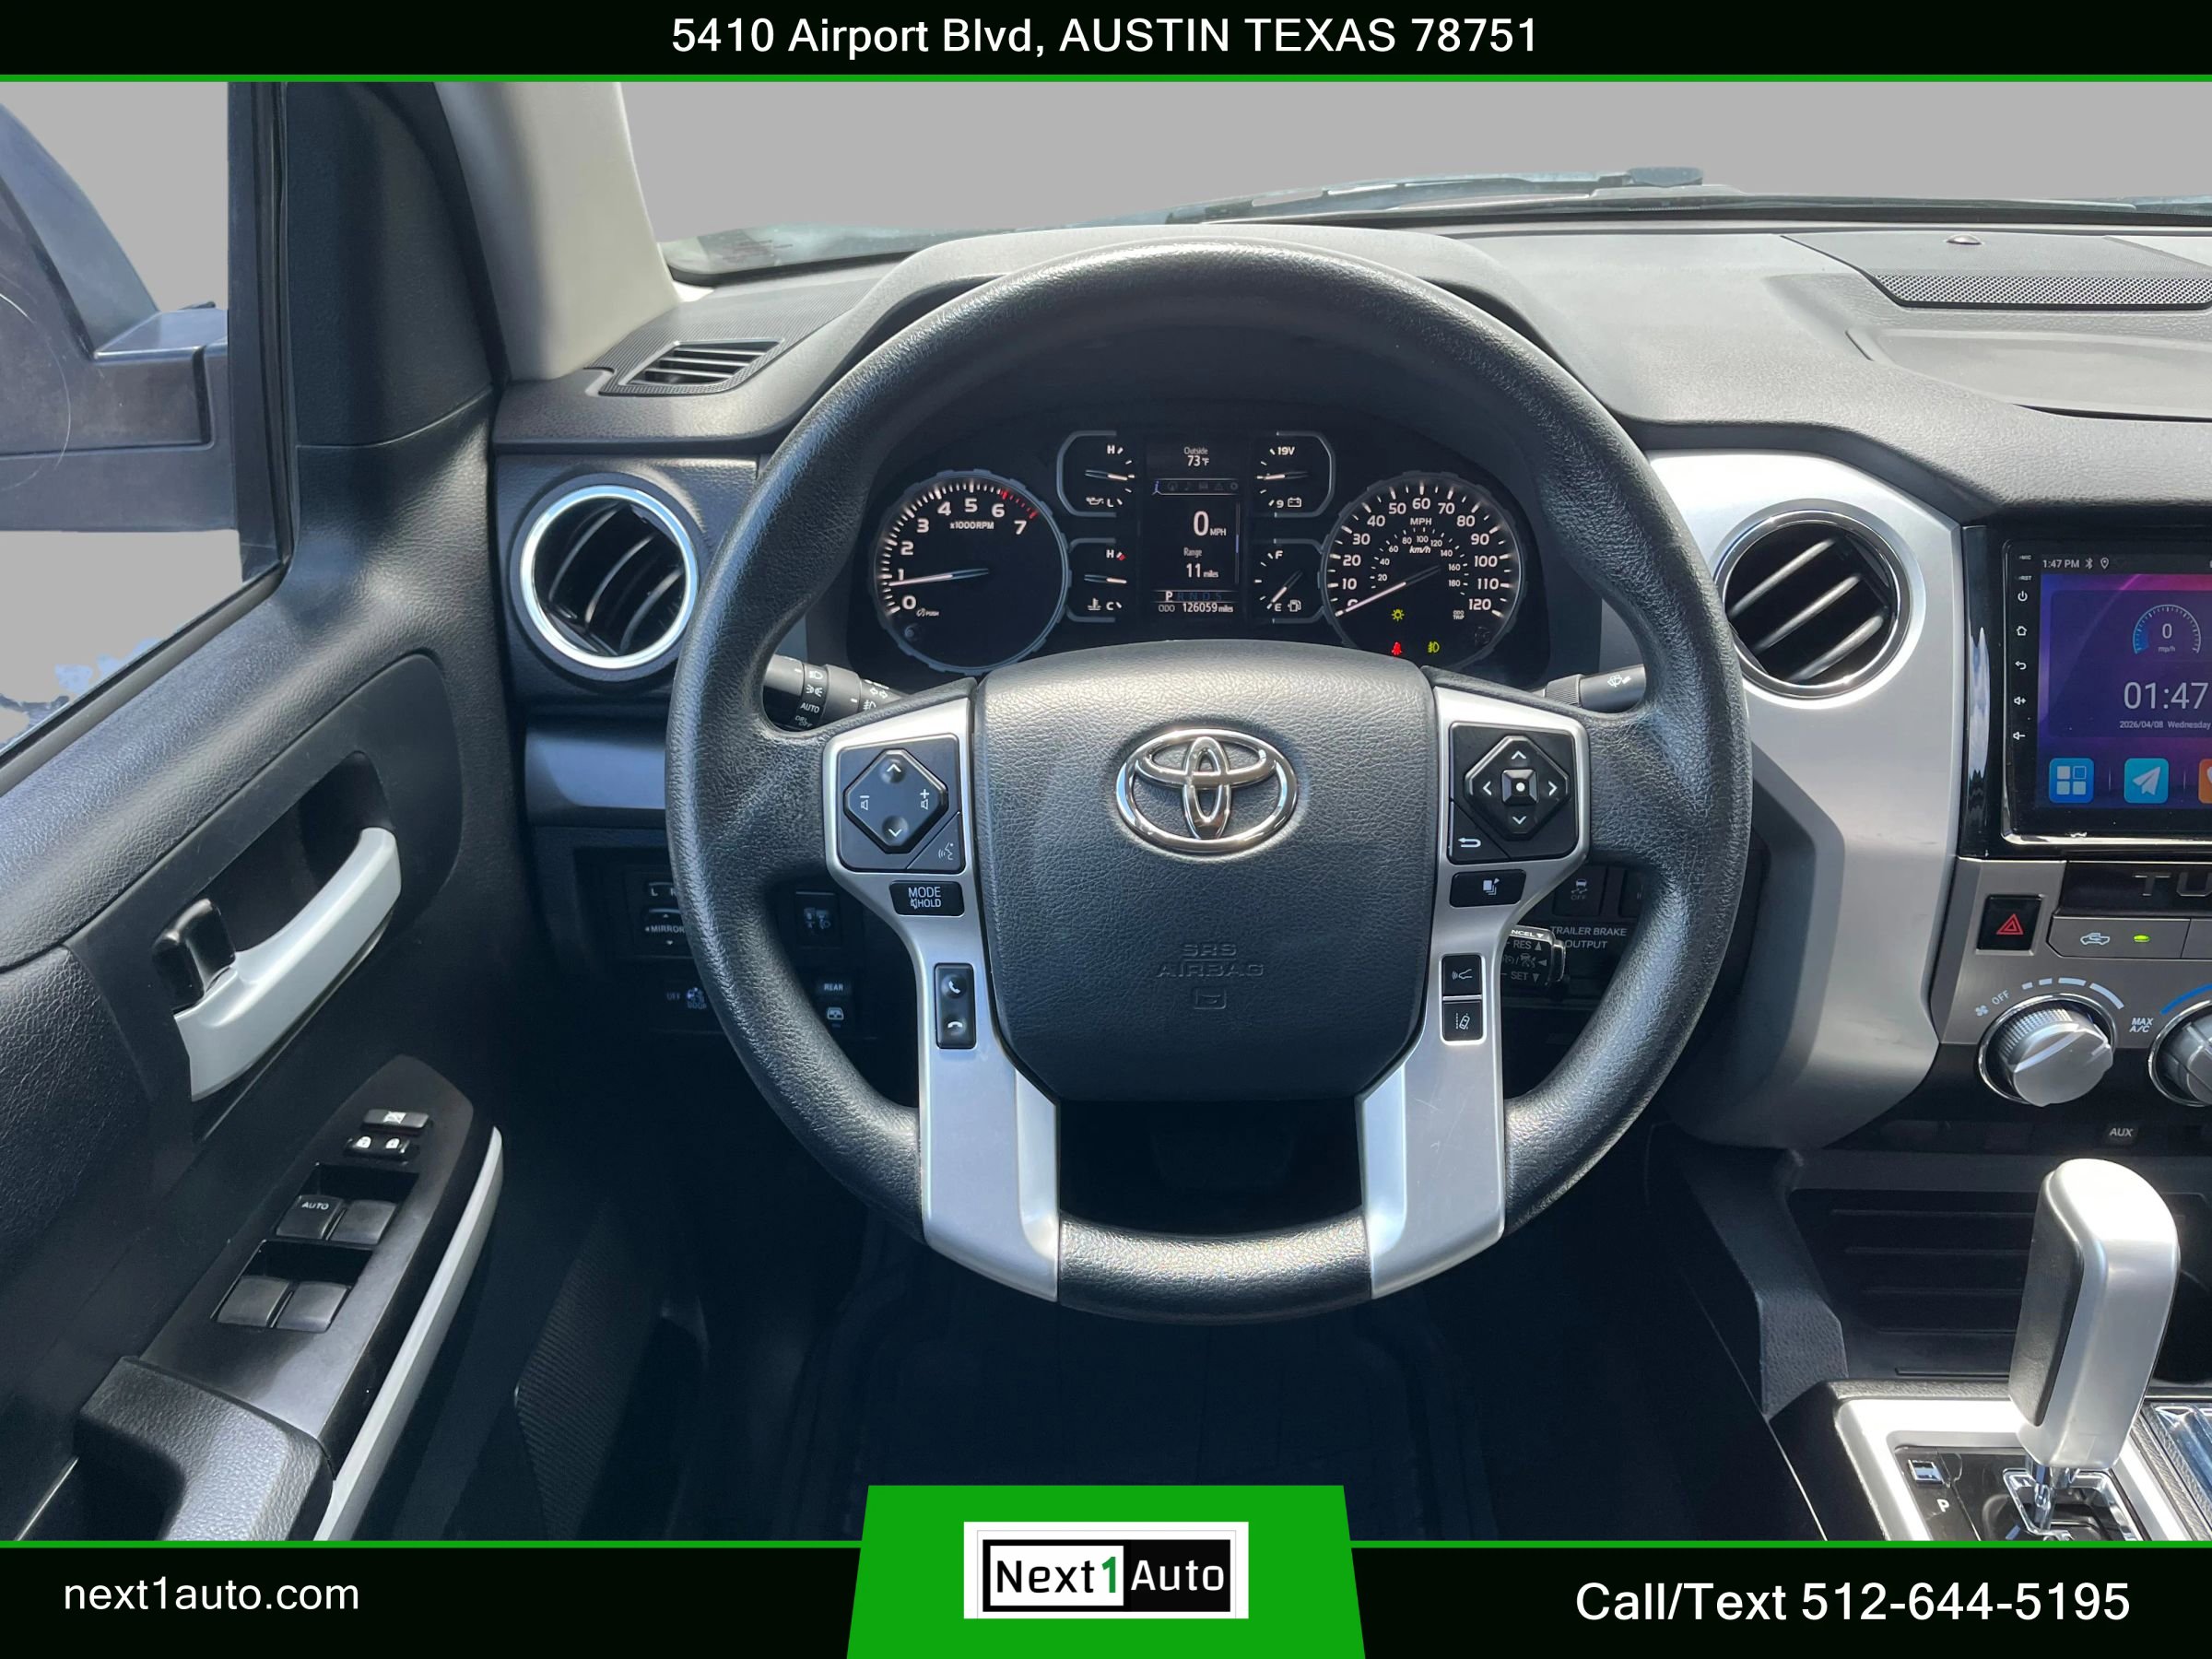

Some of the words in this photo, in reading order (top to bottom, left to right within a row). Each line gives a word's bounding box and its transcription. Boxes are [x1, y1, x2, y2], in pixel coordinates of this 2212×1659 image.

[1107, 445, 1115, 454] H
[1183, 446, 1209, 455] Outside
[1277, 446, 1295, 455] 19V
[936, 501, 952, 516] 4
[964, 498, 978, 512] 5
[1107, 499, 1113, 507] L
[1277, 500, 1284, 508] 9
[1388, 502, 1406, 514] 50
[1412, 498, 1430, 510] 60
[1437, 502, 1455, 514] 70
[992, 503, 1006, 518] 6
[916, 518, 930, 533] 3
[1193, 511, 1209, 536] 0
[1209, 528, 1227, 536] MPH
[1366, 515, 1386, 527] 40
[1409, 517, 1432, 525] MPH
[1456, 515, 1476, 527] 80
[1014, 520, 1028, 535] 7
[1352, 533, 1371, 545] 30
[1470, 533, 1489, 546] 90
[900, 541, 914, 556] 2
[1183, 547, 1203, 559] Range
[1388, 545, 1399, 553] 60
[1409, 545, 1431, 554] km/h
[1106, 550, 1115, 559] H
[1275, 550, 1283, 559] F
[1343, 555, 1361, 566] 20
[1379, 558, 1390, 566] 40
[1474, 555, 1498, 568] 100
[2042, 559, 2063, 569] 1:47
[2064, 559, 2080, 569] PM
[1186, 562, 1201, 579] 11
[1203, 570, 1219, 578] miles
[1448, 563, 1461, 571] 160
[1377, 573, 1388, 582] 20
[1342, 578, 1358, 590] 10
[1477, 578, 1500, 590] 110
[1165, 590, 1173, 602] P
[901, 594, 917, 610] 0
[1106, 602, 1114, 610] C
[1158, 604, 1176, 613] ODO
[1182, 602, 1218, 613] 126059
[1218, 605, 1234, 613] miles
[1468, 598, 1492, 610] 120
[1275, 604, 1282, 612] E
[2161, 623, 2173, 640] 0
[2123, 681, 2210, 711] 01:47
[800, 702, 820, 713] AUTO
[2119, 720, 2164, 729] 2026/04/08
[2168, 720, 2212, 731] Wednesday
[908, 886, 941, 899] MODE
[917, 898, 942, 908] HOLD
[651, 924, 686, 933] MIRROR
[1511, 929, 1535, 938] NCEL
[1549, 925, 1592, 935] TRAILER
[1593, 927, 1629, 936] BRAKE
[1512, 940, 1532, 949] RES
[1564, 939, 1608, 949] OUTPUT
[1182, 943, 1238, 957] SRS
[1156, 963, 1265, 978] AIRBAG
[1511, 971, 1529, 981] SET
[824, 982, 844, 992] REAR
[1991, 990, 2011, 1006] OFF
[2131, 1017, 2154, 1026] MAX
[2129, 1025, 2150, 1033] A/C
[2108, 1127, 2134, 1137] AUX
[301, 1201, 330, 1210] AUTO
[1936, 1499, 1950, 1512] P
